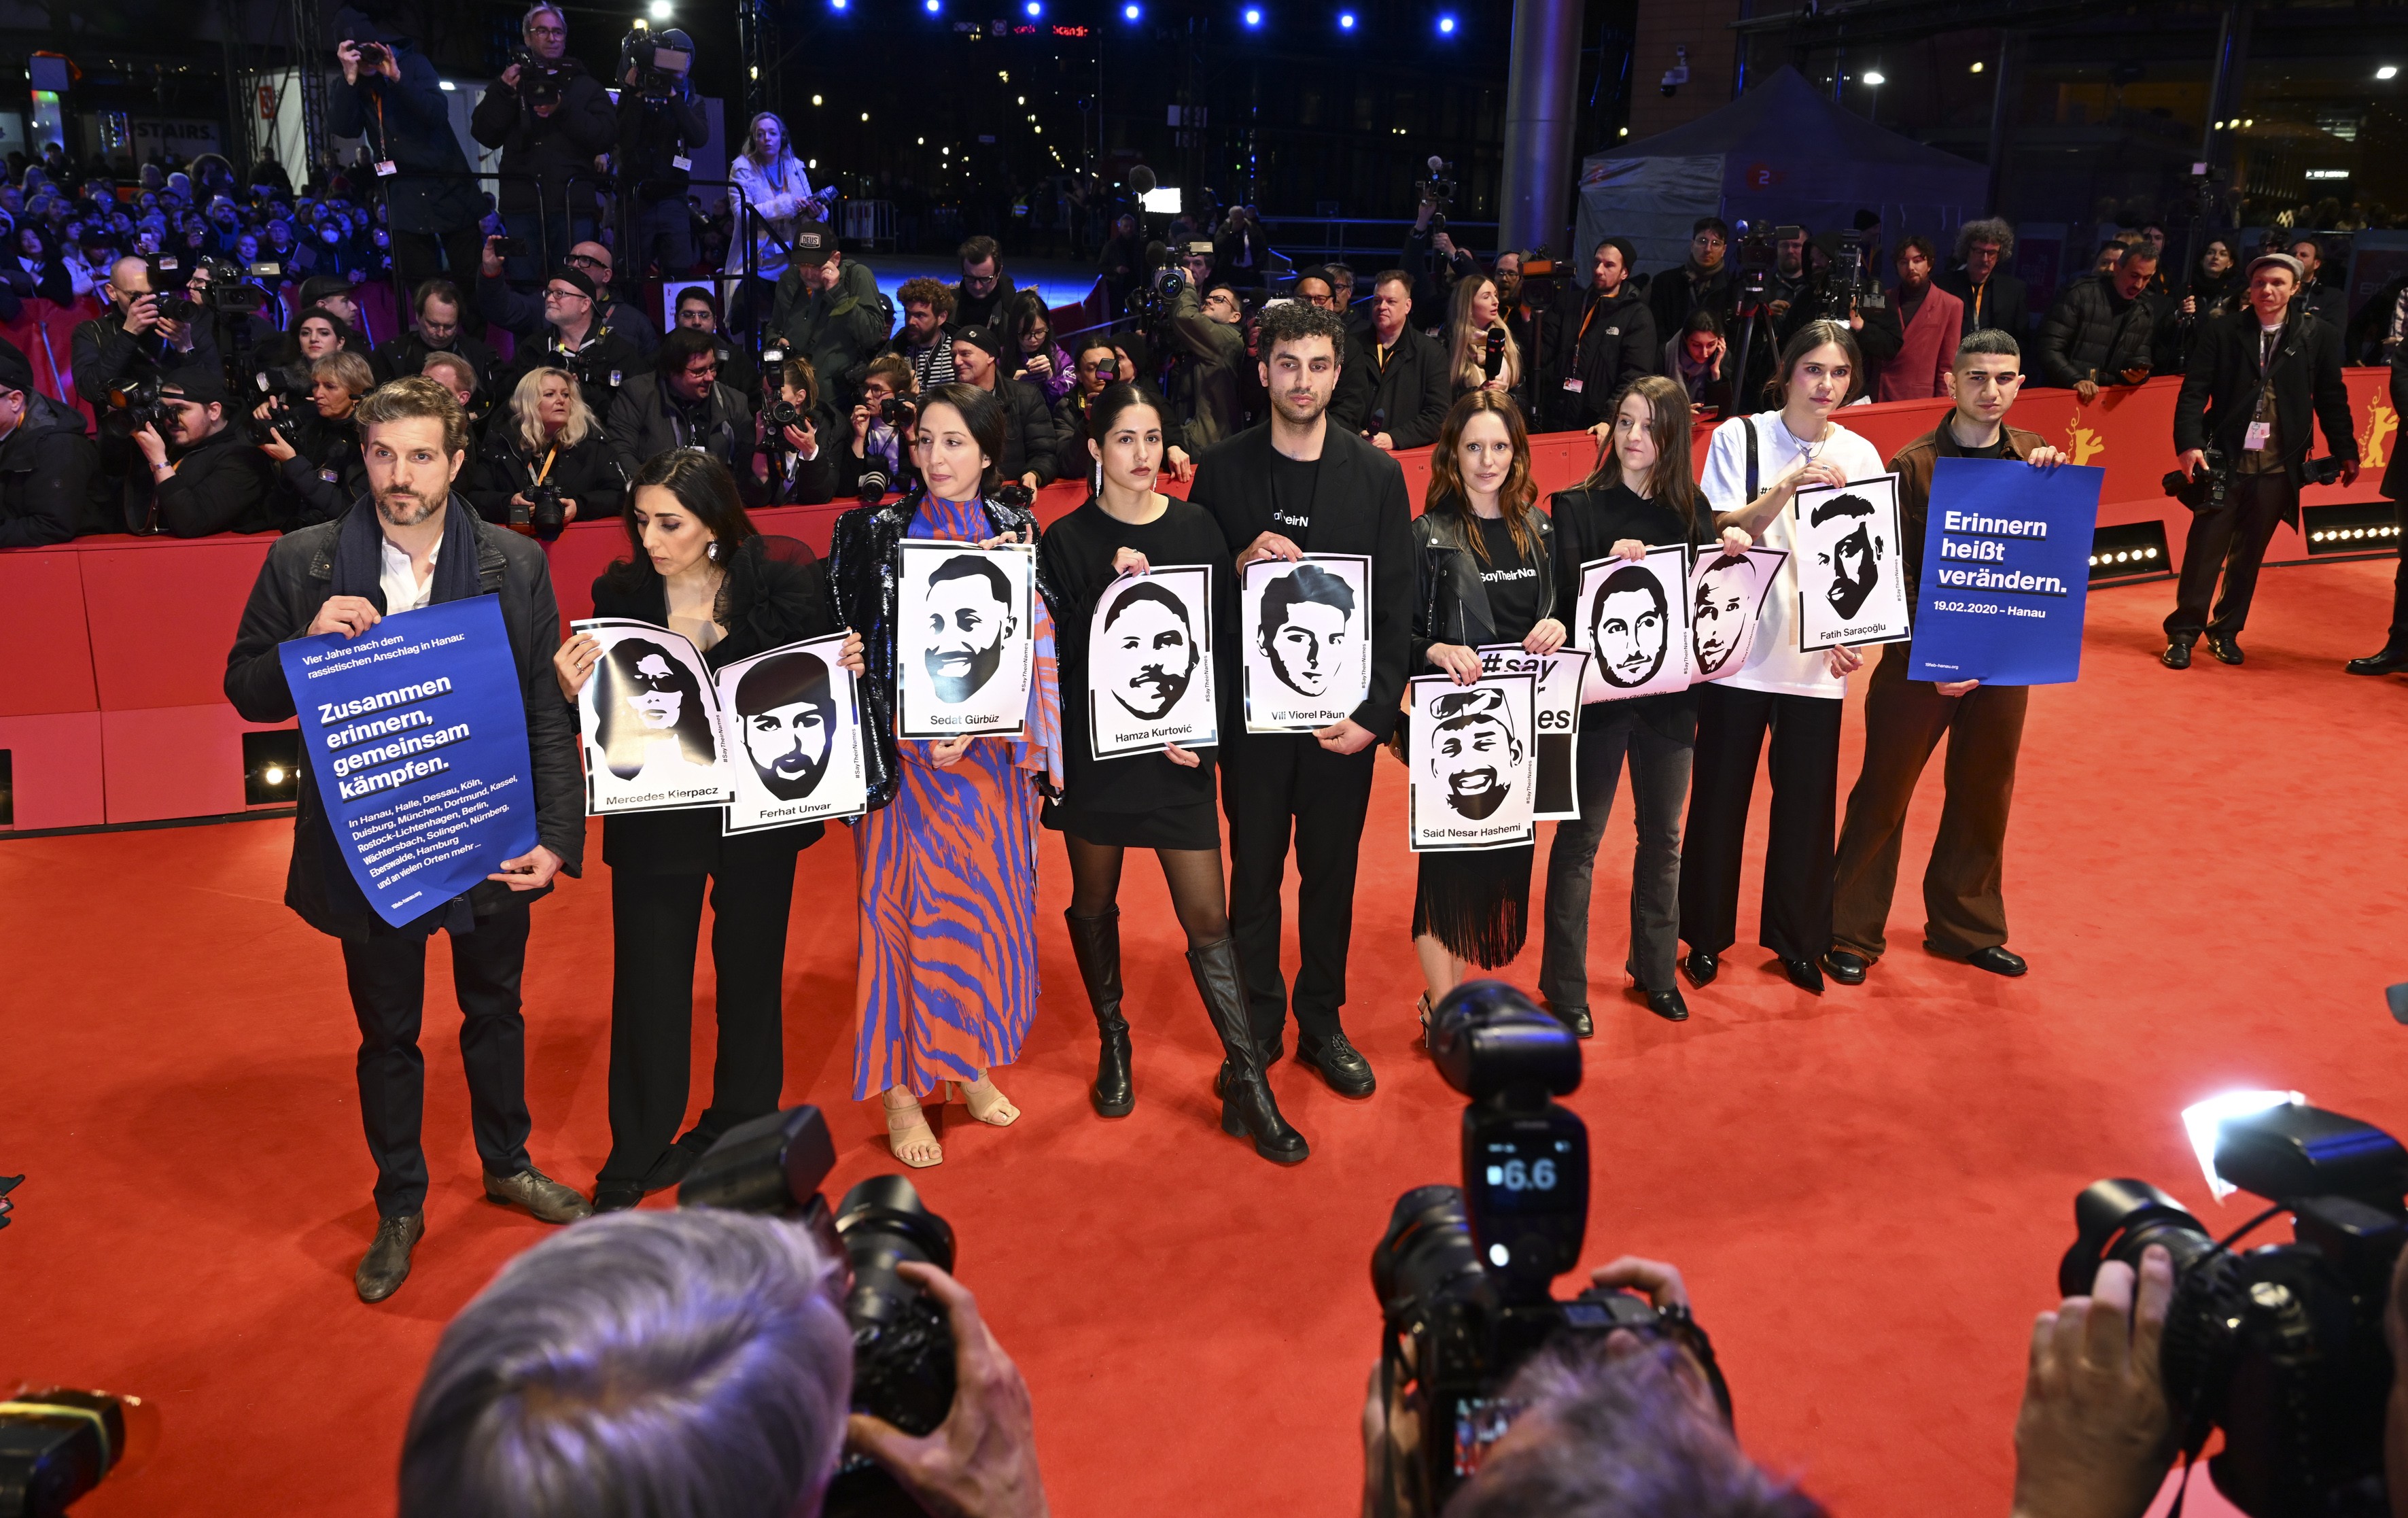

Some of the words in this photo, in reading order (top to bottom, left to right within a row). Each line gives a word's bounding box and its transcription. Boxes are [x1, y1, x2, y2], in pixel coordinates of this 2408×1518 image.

[803, 236, 818, 244] DEUS
[1944, 511, 2047, 536] Erinnern
[1942, 538, 2005, 561] heißt
[1938, 568, 2067, 593] verändern.
[1934, 600, 1997, 615] 19.02.2020
[2007, 606, 2046, 618] Hanau
[1820, 629, 1842, 640] Fatih
[1844, 623, 1886, 636] Saraçoğlu
[302, 653, 323, 666] Vier
[325, 646, 352, 660] Jahre
[353, 640, 380, 654] nach
[381, 634, 404, 647] dem
[308, 656, 372, 680] rassistischen
[373, 644, 420, 663] Anschlag
[420, 642, 430, 651] in
[430, 633, 466, 649] Hanau:
[1482, 653, 1559, 683] #say
[317, 676, 452, 724] Zusammen
[1289, 710, 1317, 719] Viorel
[1320, 710, 1345, 719] Păun
[326, 710, 434, 748] erinnern,
[930, 715, 962, 725] Sedat
[964, 714, 1000, 724] Gürbüz
[1115, 730, 1149, 743] Hamza
[1151, 724, 1192, 738] Kurtović
[333, 723, 470, 778] gemeinsam
[716, 714, 728, 763] #SayTheirNames
[852, 728, 860, 778] #SayTheirNames
[338, 756, 449, 799] kämpfen.
[349, 819, 358, 828] In
[360, 809, 394, 825] Hanau,
[395, 799, 421, 814] Halle,
[423, 787, 459, 804] Dessau,
[460, 778, 483, 791] Köln,
[352, 821, 396, 841] Duisburg,
[398, 805, 443, 823] München,
[444, 789, 489, 809] Dortmund,
[490, 775, 518, 792] Kassel,
[606, 791, 665, 806] Mercedes
[667, 787, 719, 801] Kierpacz
[760, 806, 797, 819] Ferhat
[799, 802, 832, 814] Unvar
[357, 811, 461, 853] Rostock-Lichtenhagen,
[461, 801, 489, 816] Berlin,
[363, 835, 425, 865] Wächtersbach,
[427, 821, 469, 840] Solingen,
[470, 804, 509, 825] Nürnberg,
[1423, 828, 1445, 838] Said
[1448, 828, 1478, 837] Nesar
[1480, 823, 1521, 837] Hashemi
[369, 852, 415, 878] Eberswalde,
[416, 837, 459, 857] Hamburg
[377, 876, 391, 889] und
[391, 873, 400, 882] an
[400, 862, 423, 878] vielen
[423, 852, 450, 866] Orten
[1502, 1157, 1558, 1192] 6.6
